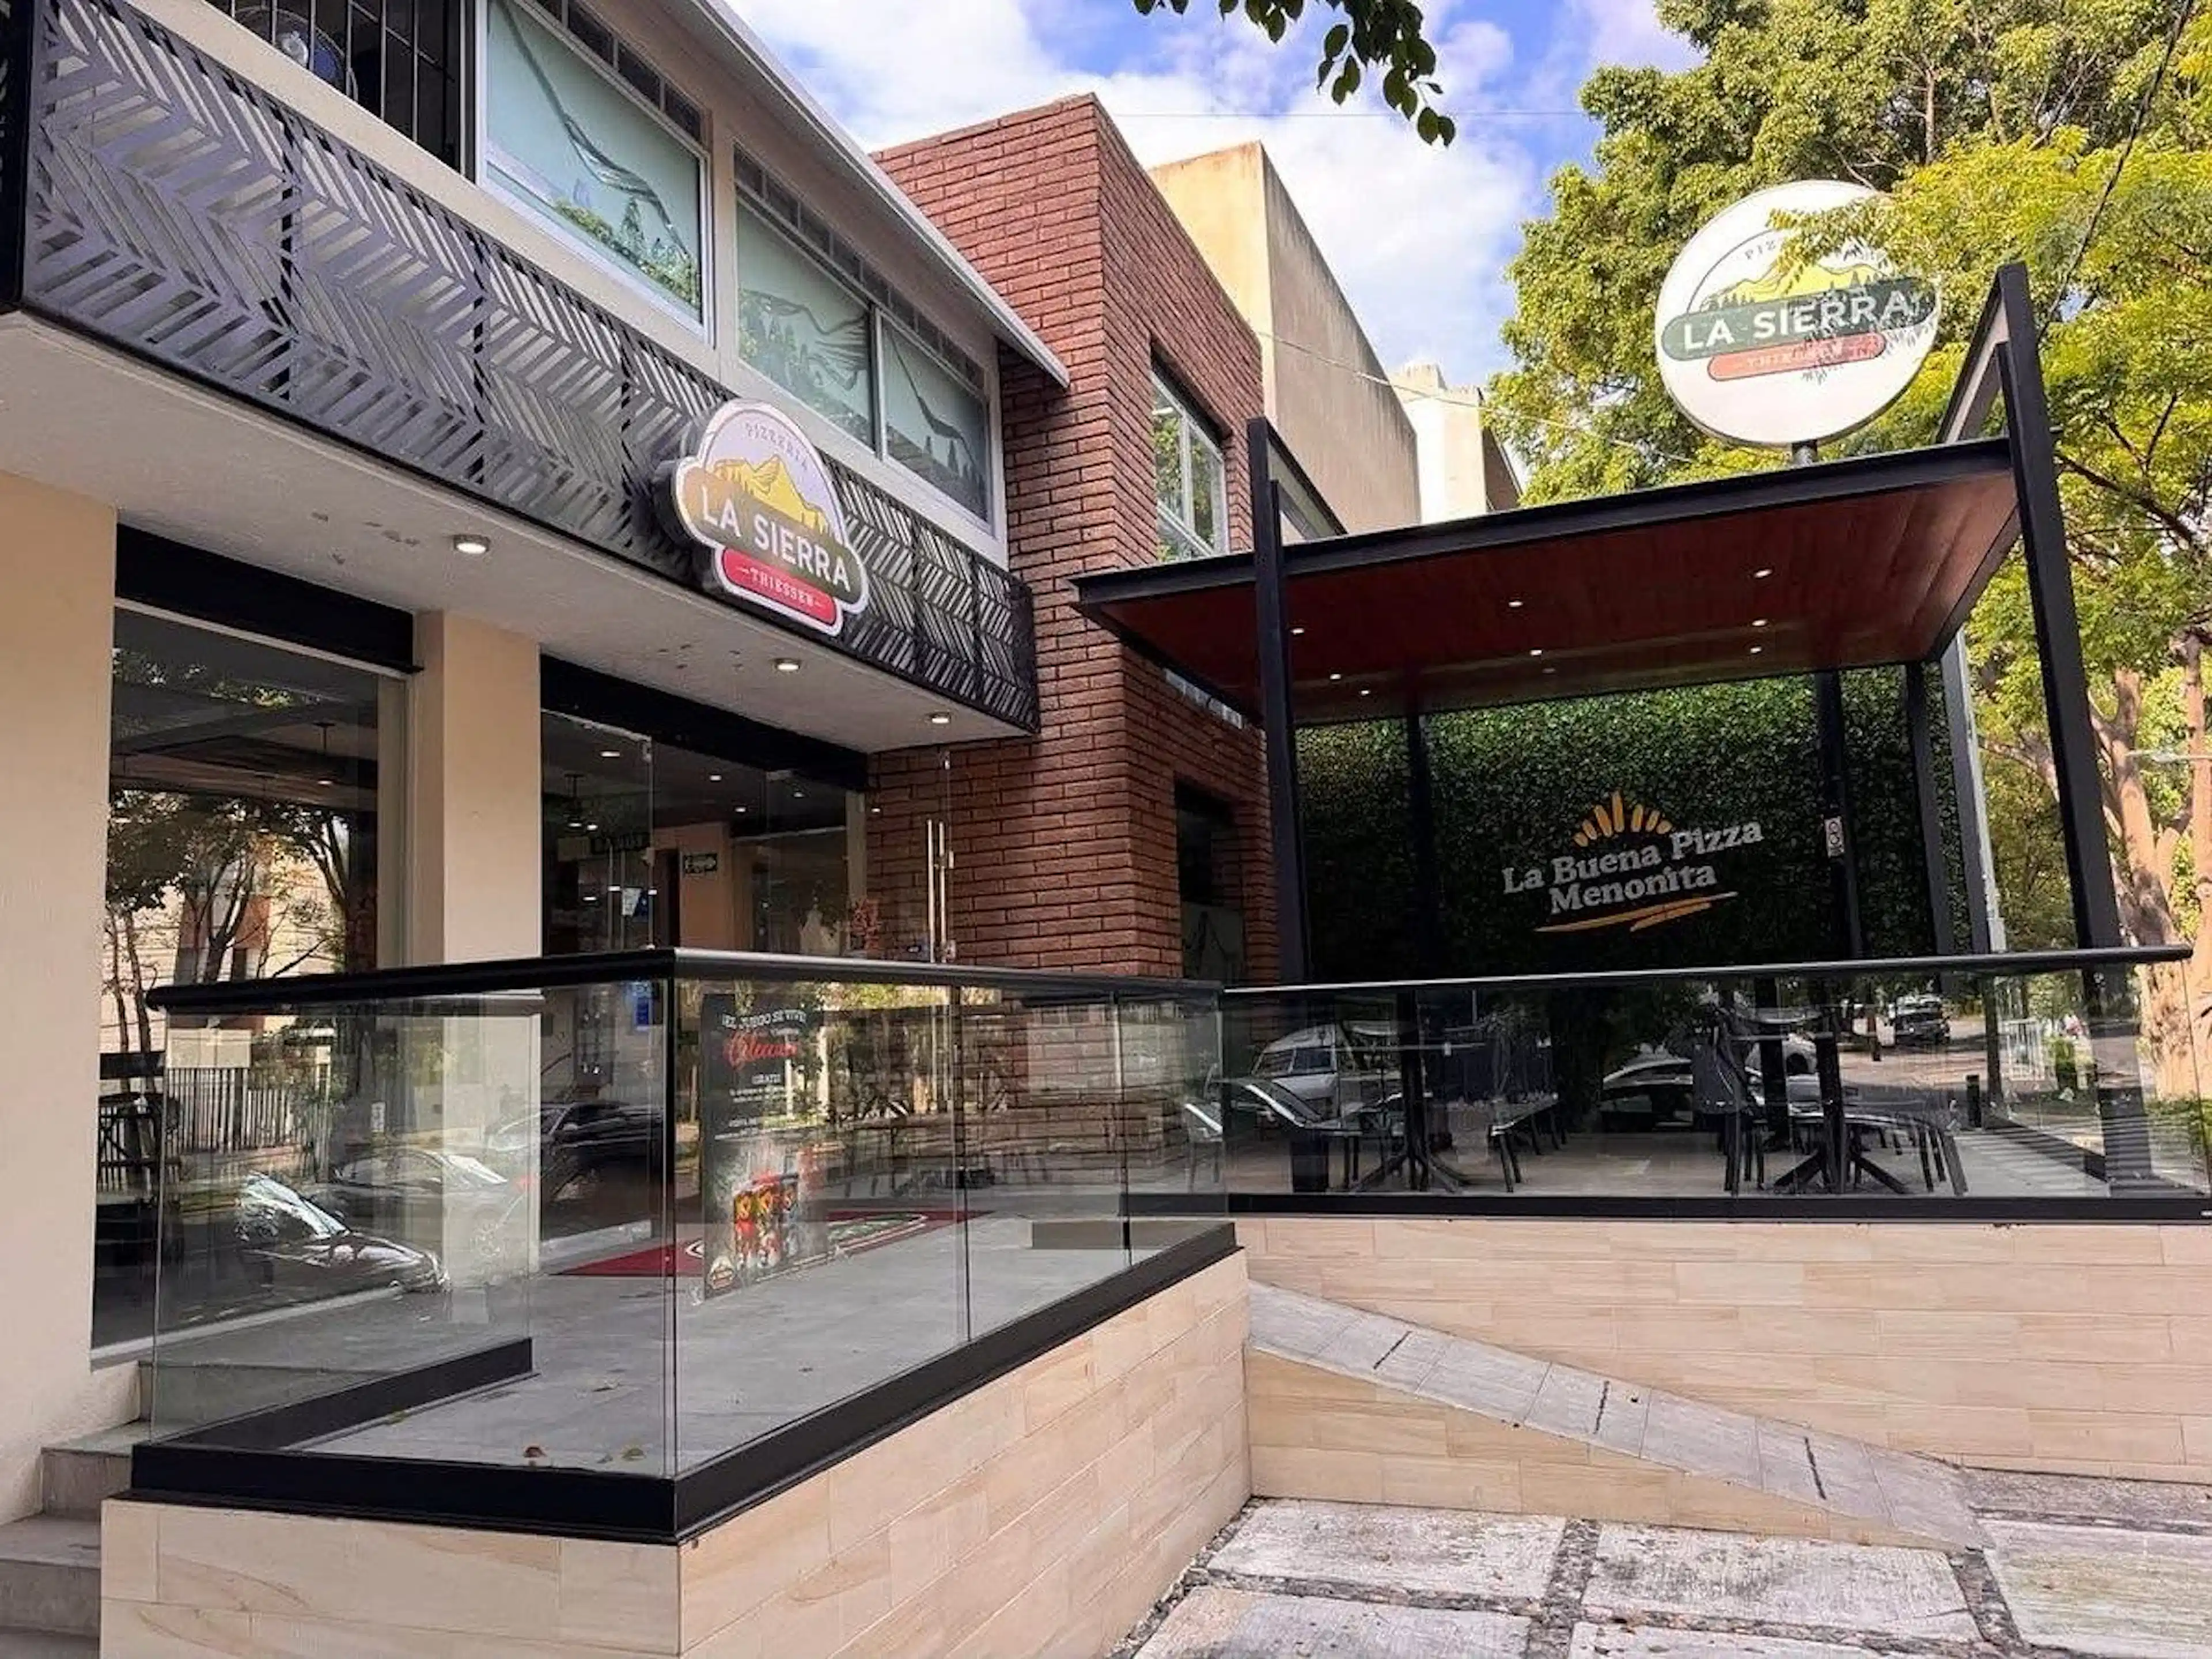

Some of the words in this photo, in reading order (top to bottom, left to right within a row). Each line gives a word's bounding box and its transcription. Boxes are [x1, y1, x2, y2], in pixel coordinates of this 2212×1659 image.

[1683, 318, 1735, 350] LA
[1752, 290, 1913, 340] SIERRA
[702, 485, 743, 538] LA
[753, 513, 851, 593] SIERRA
[1501, 866, 1545, 894] La
[1551, 844, 1662, 885] Buena
[1670, 821, 1764, 859] Pizza
[1548, 864, 1718, 915] Menonita
